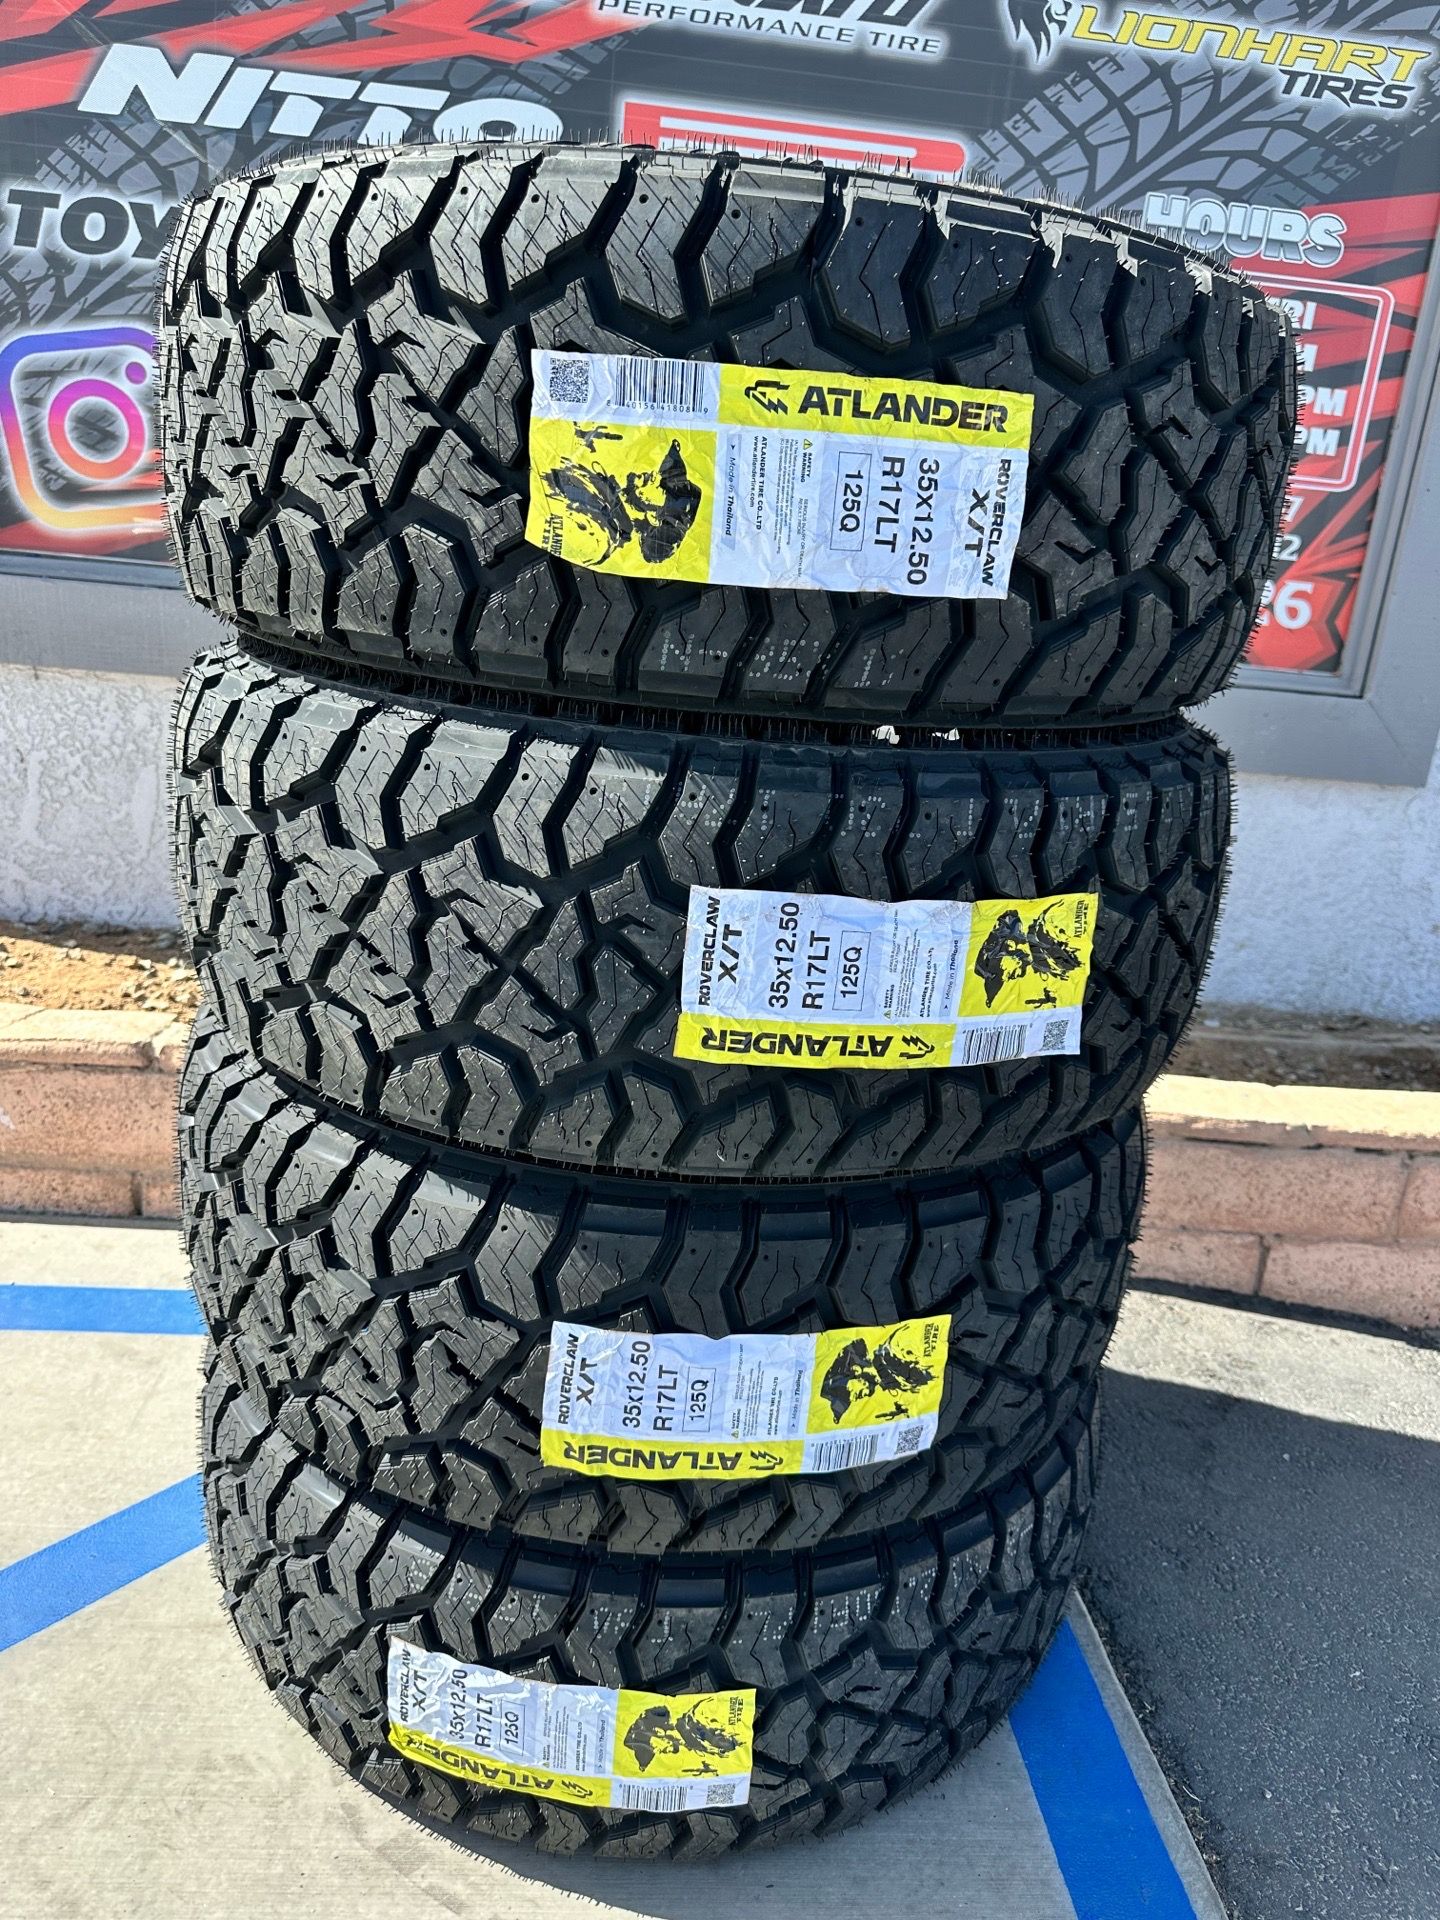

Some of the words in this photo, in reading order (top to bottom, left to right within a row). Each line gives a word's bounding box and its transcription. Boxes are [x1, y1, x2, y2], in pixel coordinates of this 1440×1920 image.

[597, 0, 854, 43] PERFORMANCE
[868, 30, 942, 54] TIRE
[1072, 4, 1432, 82] LIONHART
[1279, 69, 1415, 109] TIRES
[1144, 192, 1347, 268] HOURS
[797, 385, 1009, 433] ATLANDER
[728, 457, 736, 483] Made
[749, 436, 759, 508] www.atlandertire.com
[759, 436, 767, 478] ATLANDER
[728, 484, 735, 493] in
[757, 481, 765, 497] TIRE
[838, 469, 864, 533] 125Q
[874, 456, 906, 553] R17LT
[725, 496, 734, 536] Thailand
[964, 488, 991, 558] X/T
[981, 458, 1012, 587] ROVERCLAW
[1073, 900, 1085, 938] ATLANDER
[698, 895, 721, 1006] ROVERCLAW
[717, 924, 743, 984] X/T
[801, 930, 831, 1010] R17LT
[840, 946, 863, 998] 125Q
[919, 987, 930, 1017] ATLANDER
[701, 1027, 894, 1058] ATLANDER
[931, 1325, 939, 1352] TIRE
[558, 1333, 580, 1425] ROVERCLAW
[576, 1357, 598, 1406] X/T
[653, 1364, 678, 1431] R17LT
[689, 1379, 710, 1421] 125Q
[563, 1440, 743, 1471] ATLANDER
[399, 1649, 412, 1723] ROVERCLAW
[411, 1669, 428, 1712] X/T
[474, 1693, 493, 1748] R17LT
[504, 1711, 520, 1745] 125Q
